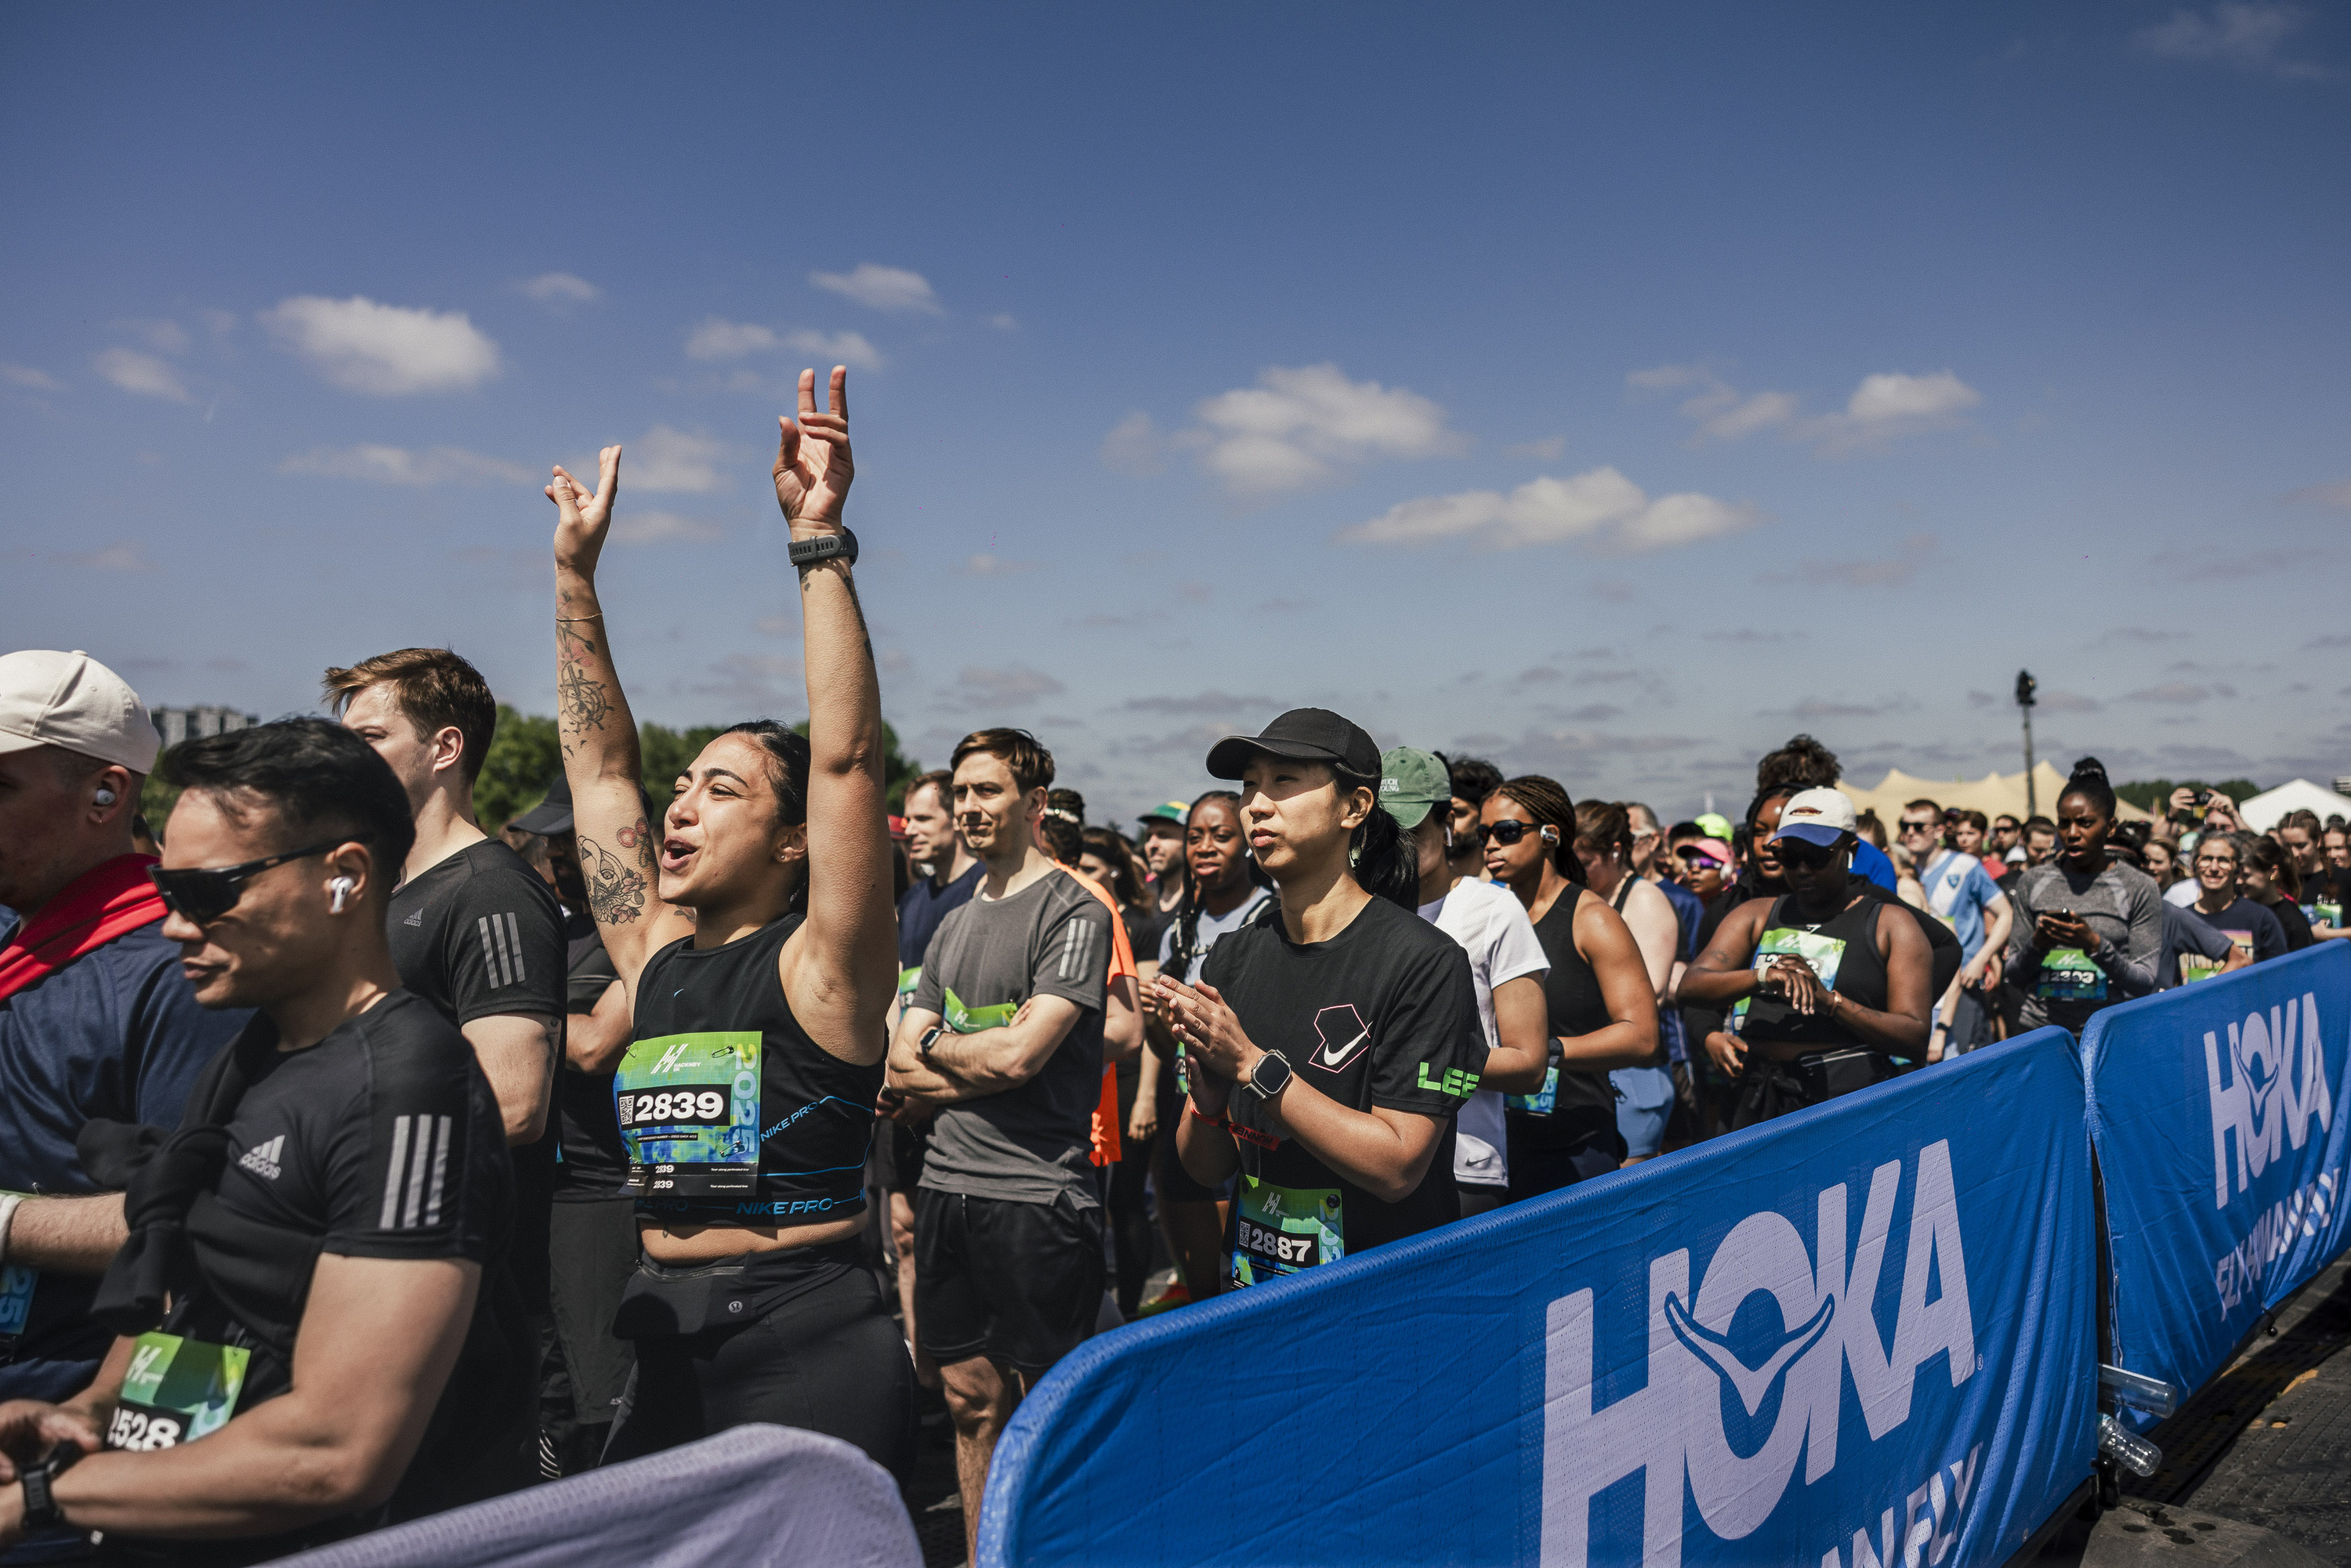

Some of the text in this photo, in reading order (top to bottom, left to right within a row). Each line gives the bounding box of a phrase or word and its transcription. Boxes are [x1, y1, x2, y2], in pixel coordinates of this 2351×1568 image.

[1417, 1061, 1480, 1099] LEE
[2203, 991, 2331, 1210] HOKA
[635, 1091, 724, 1122] 2839
[760, 1102, 818, 1143] NIKE PRO
[237, 1152, 282, 1181] adidas
[736, 1197, 834, 1215] NIKE PRO
[1250, 1228, 1312, 1262] 2887
[1319, 1199, 1342, 1265] 202
[0, 1267, 31, 1324] 25
[1538, 1138, 1976, 1568] HOKA
[1904, 1440, 1984, 1568] FLY
